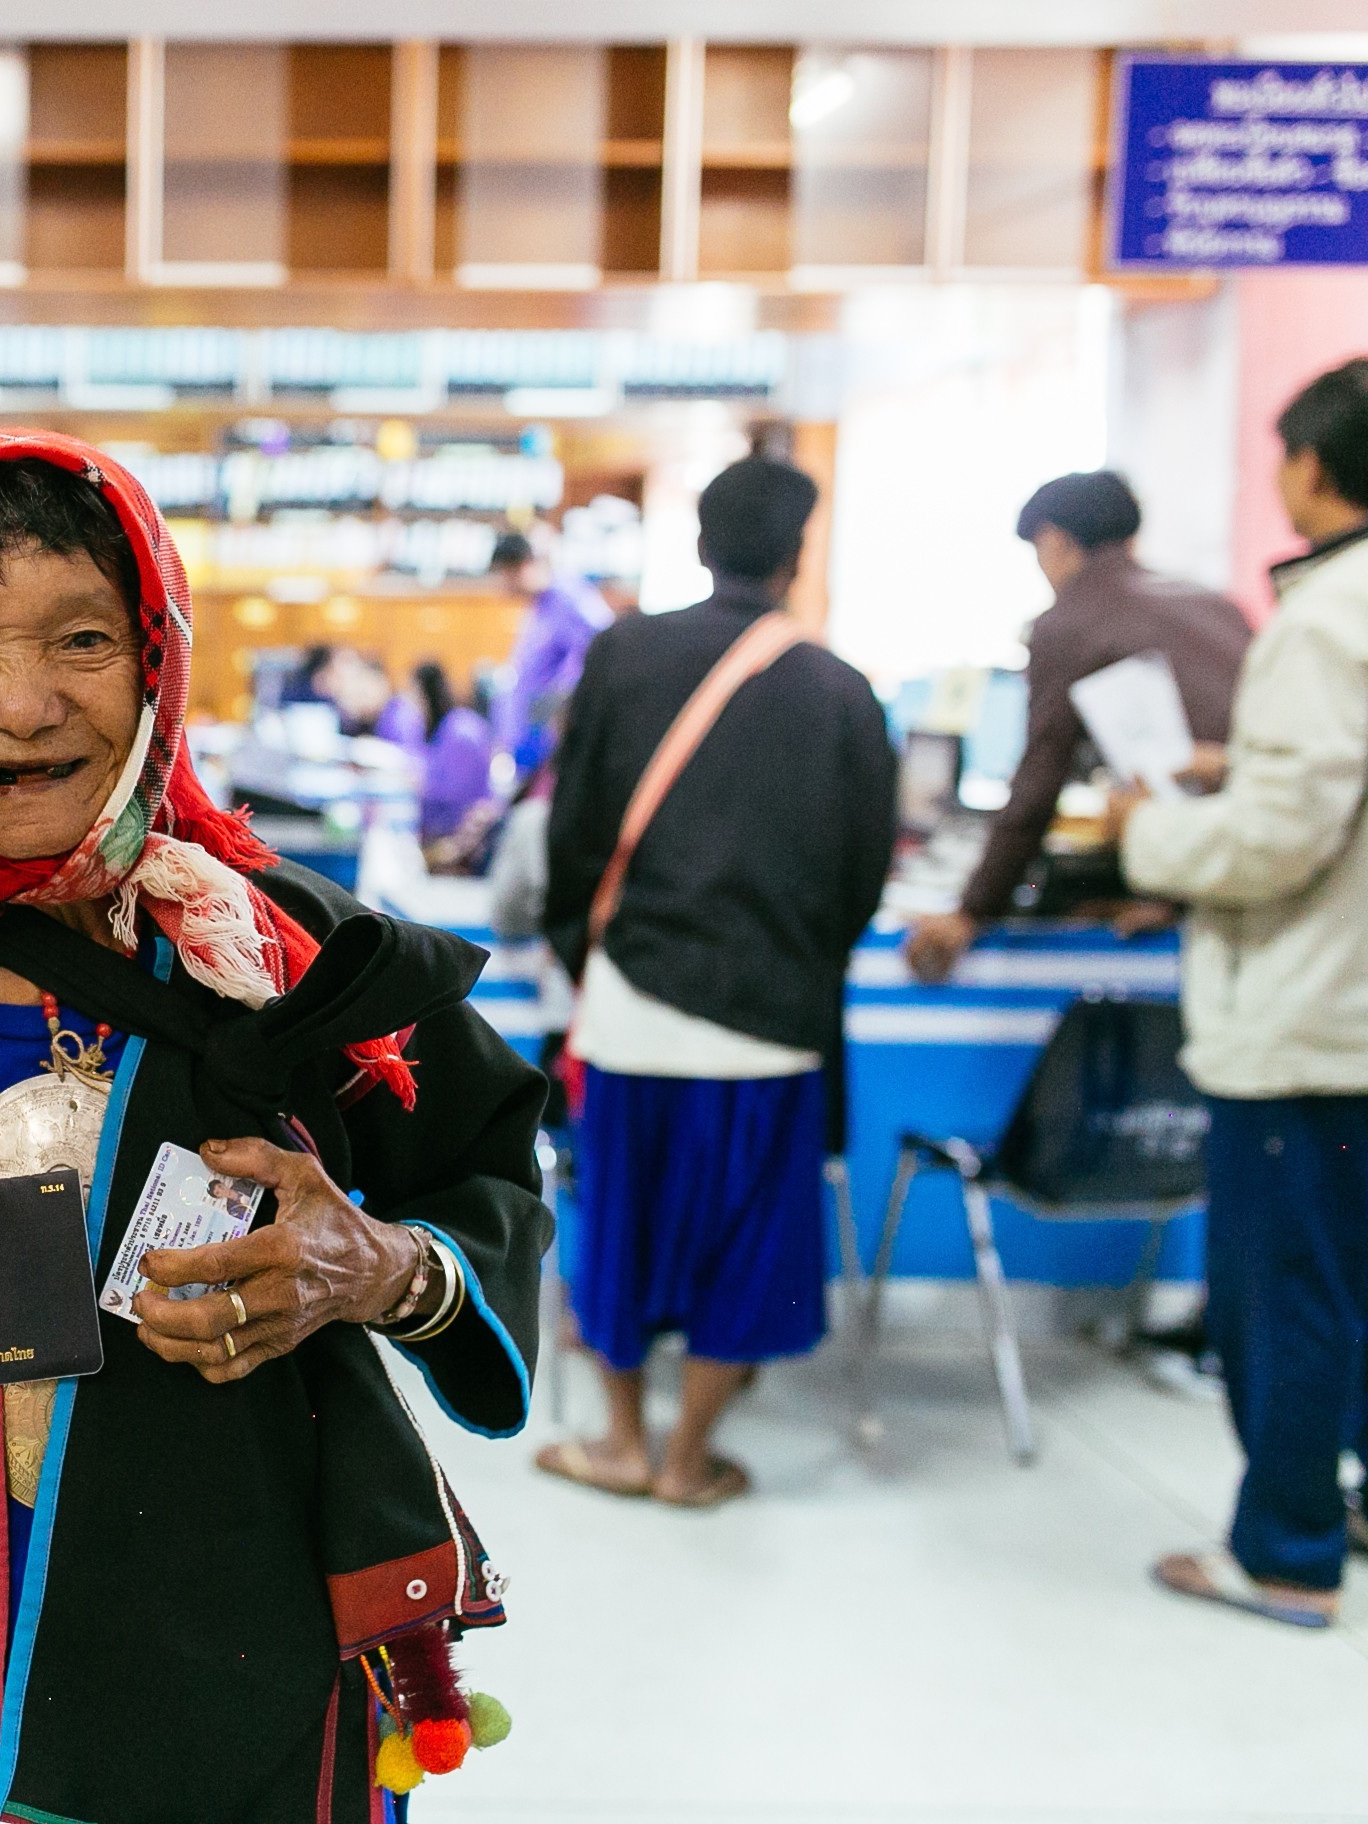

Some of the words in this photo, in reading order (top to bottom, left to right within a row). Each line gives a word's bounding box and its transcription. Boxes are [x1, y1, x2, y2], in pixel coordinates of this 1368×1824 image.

[140, 1201, 151, 1215] Thai
[147, 1172, 162, 1199] National
[158, 1162, 166, 1171] ID
